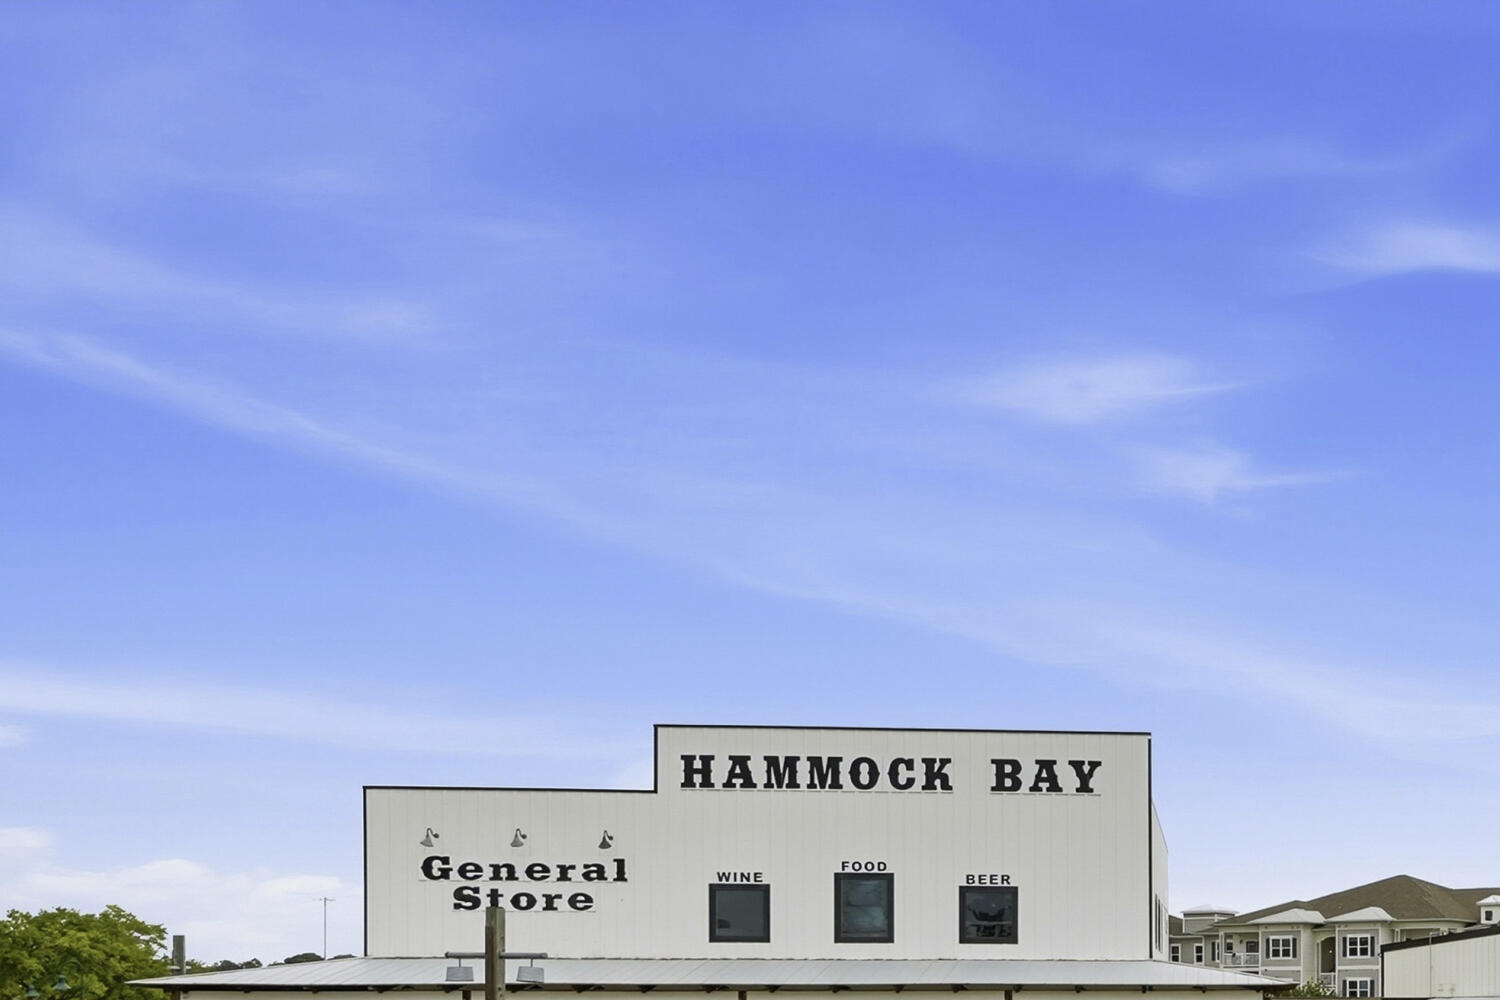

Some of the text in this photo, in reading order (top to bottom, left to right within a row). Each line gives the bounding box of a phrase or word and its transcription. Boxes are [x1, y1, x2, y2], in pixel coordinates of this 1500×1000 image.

[680, 754, 1102, 794] HAMMOCK BAY
[420, 855, 628, 882] General
[841, 861, 888, 872] FOOD
[717, 871, 764, 883] WINE
[966, 874, 1012, 885] BEER
[453, 886, 594, 911] Store
